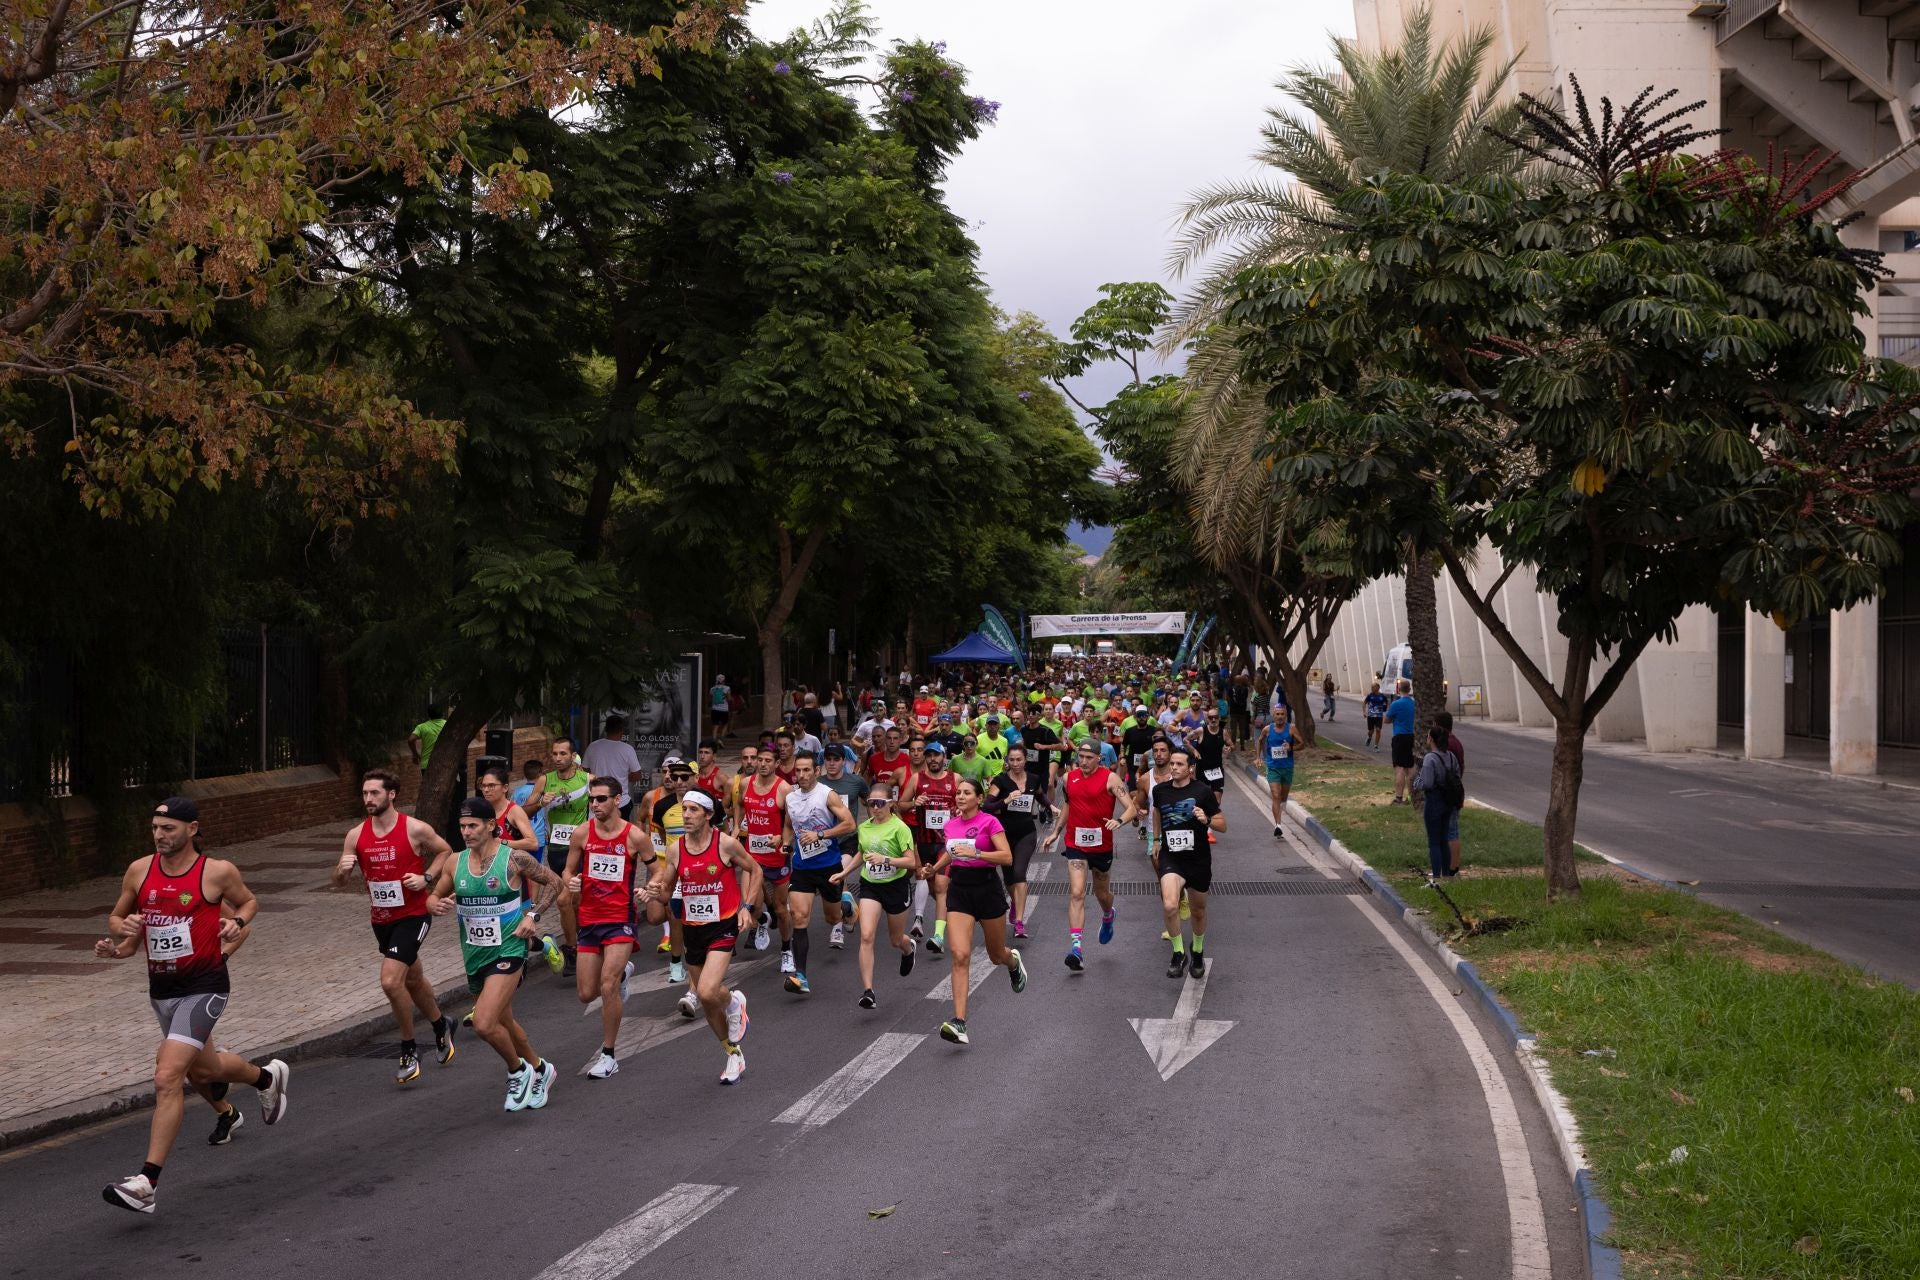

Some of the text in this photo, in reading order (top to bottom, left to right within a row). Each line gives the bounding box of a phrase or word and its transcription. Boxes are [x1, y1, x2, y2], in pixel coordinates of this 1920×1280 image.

[931, 816, 943, 824] 58
[1081, 834, 1095, 842] 90
[1169, 837, 1189, 846] 931
[593, 862, 618, 873] 273
[869, 864, 891, 873] 478
[682, 881, 723, 893] CARTAMA
[373, 889, 396, 900] 894
[461, 896, 498, 905] ATLETISMO
[689, 904, 714, 914] 624
[469, 927, 494, 938] 403
[150, 936, 183, 950] 732
